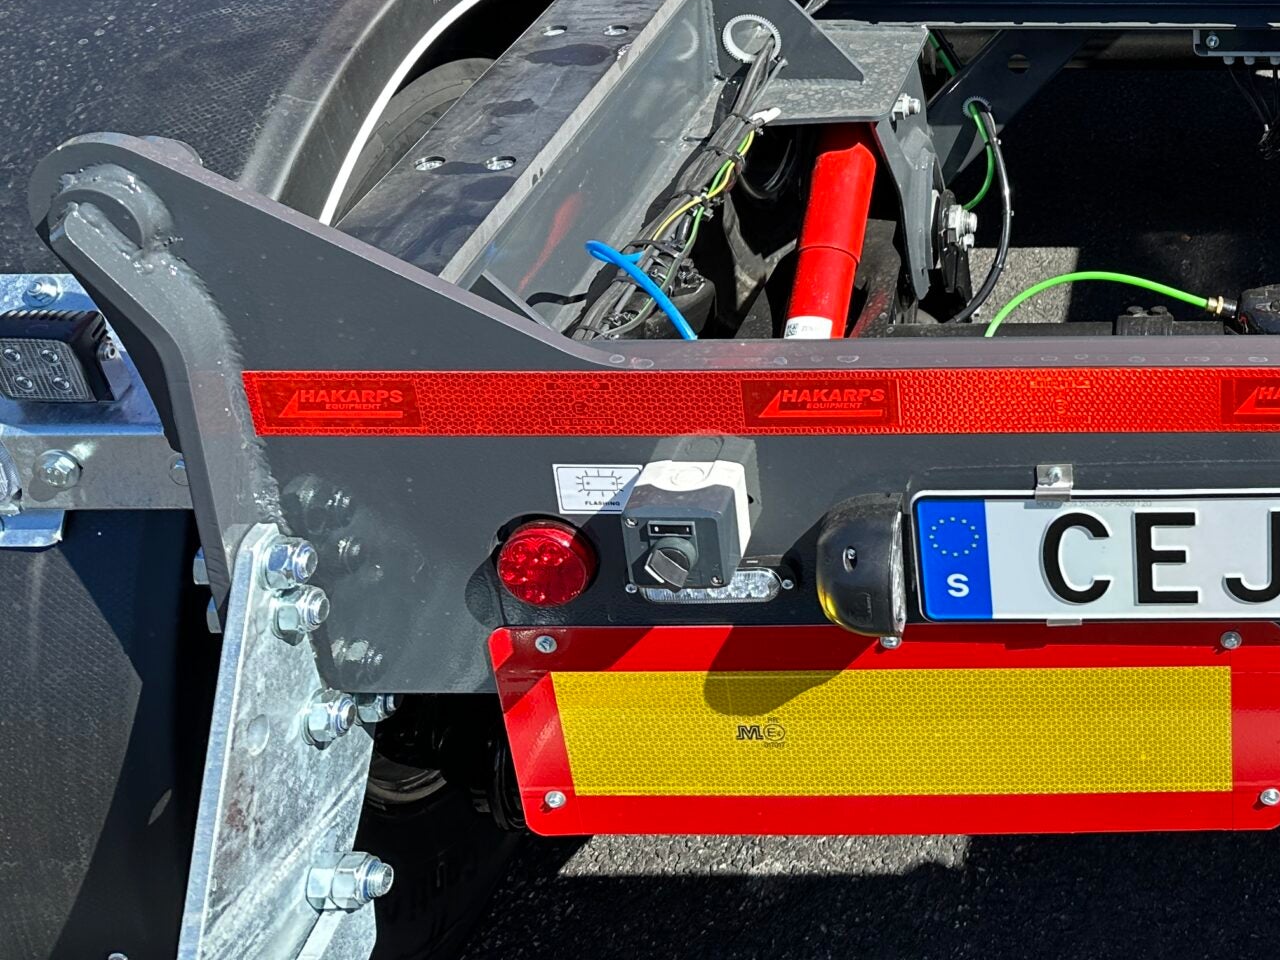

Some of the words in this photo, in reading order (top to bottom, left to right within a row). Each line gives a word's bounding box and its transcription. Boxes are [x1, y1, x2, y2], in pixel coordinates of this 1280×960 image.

[300, 389, 404, 403] HAKARPS
[782, 389, 885, 402] HAKARPS
[946, 573, 970, 598] S
